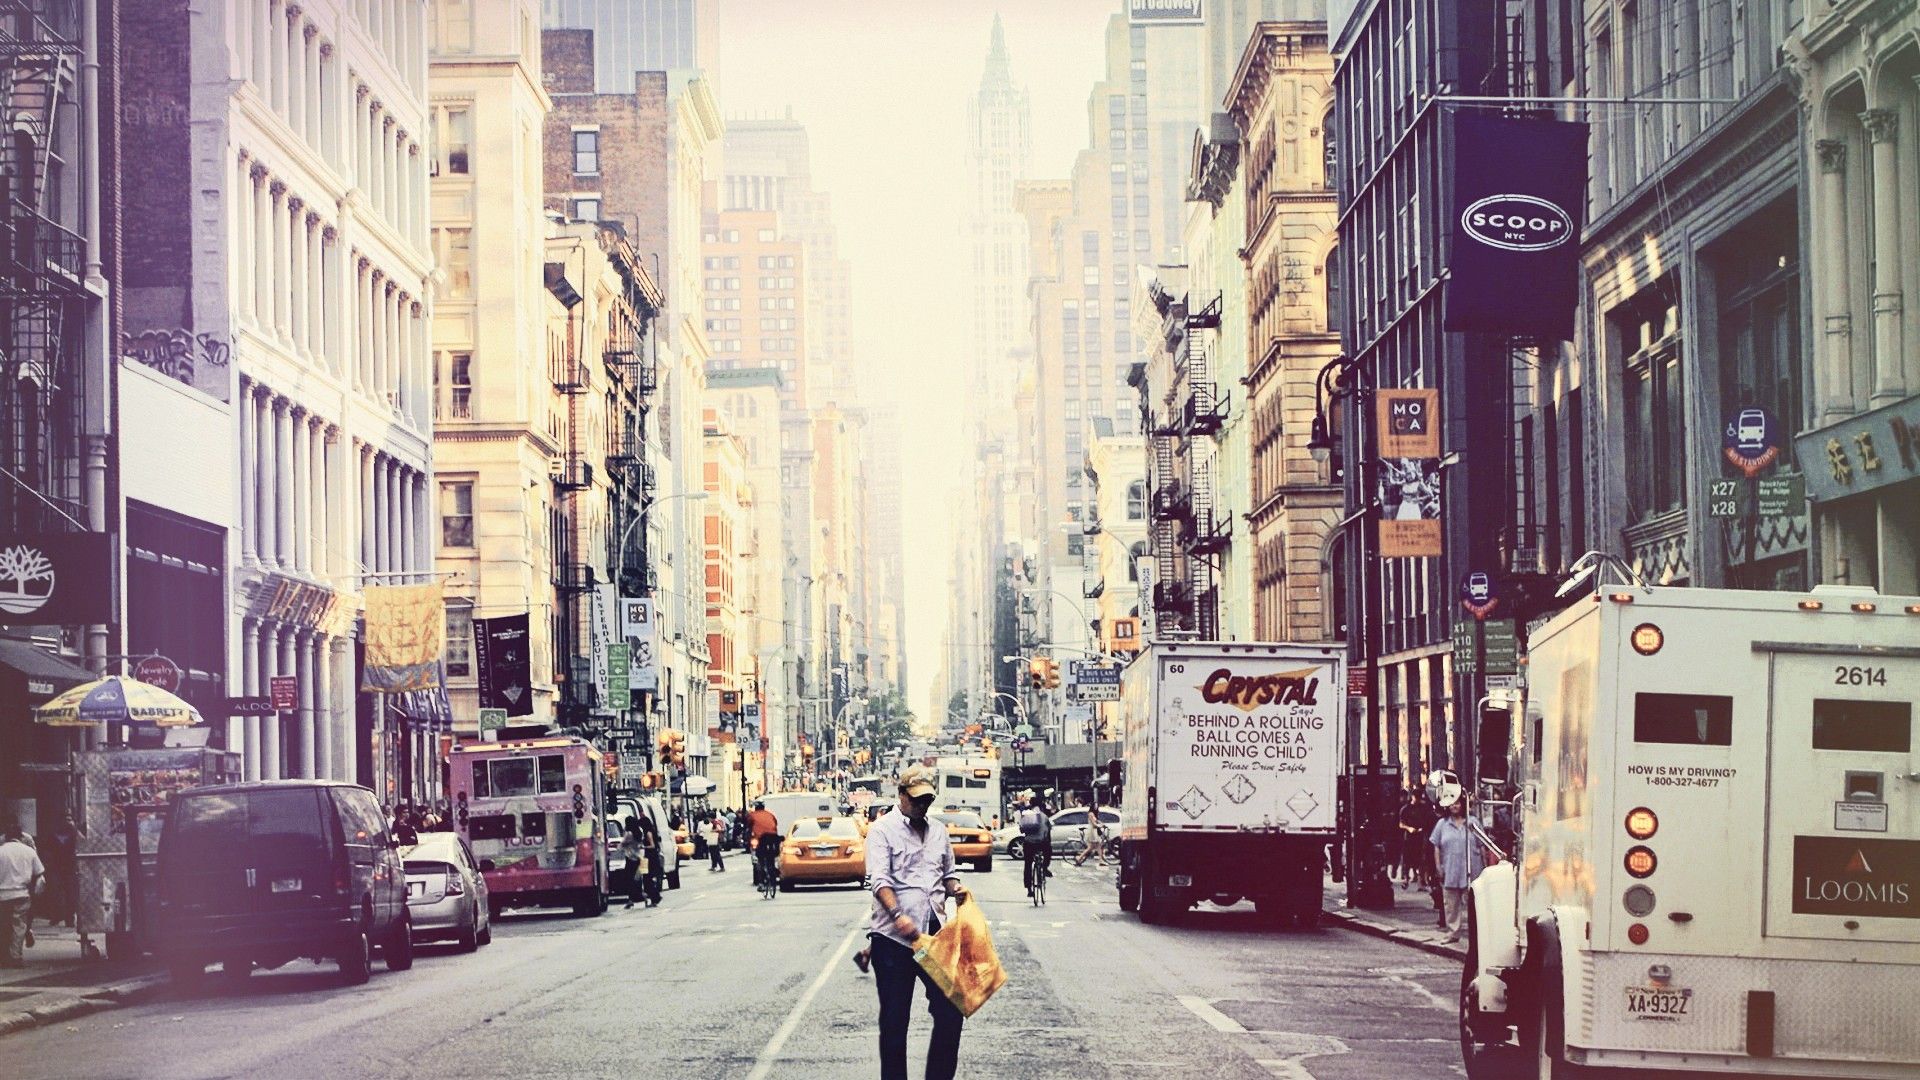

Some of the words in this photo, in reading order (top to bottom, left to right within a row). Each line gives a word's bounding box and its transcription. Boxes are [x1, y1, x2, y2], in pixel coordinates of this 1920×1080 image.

[1473, 213, 1562, 232] SCOOP
[1504, 232, 1526, 240] NYC
[140, 665, 173, 675] Jewelry
[1169, 664, 1184, 674] 60
[1835, 666, 1887, 687] 2614
[1202, 668, 1318, 706] CRYSTAL
[131, 707, 184, 717] SABRETT
[234, 702, 272, 711] ALDO
[1289, 706, 1315, 717] Says
[1183, 714, 1240, 728] "BEHIND
[1244, 716, 1255, 728] A
[1260, 716, 1324, 730] ROLLING
[1196, 730, 1231, 743] BALL
[1236, 731, 1290, 744] COMES
[1294, 732, 1305, 744] A
[1191, 745, 1259, 758] RUNNING
[1264, 745, 1313, 759] CHILD"
[1222, 761, 1249, 771] Please
[1252, 761, 1275, 771] Drive
[1278, 762, 1307, 774] Safely
[1628, 765, 1653, 775] HOW
[1656, 766, 1666, 775] IS
[1669, 767, 1685, 776] MY
[1687, 768, 1737, 777] DRIVING?
[1646, 777, 1719, 787] 1-800-327-4677
[1804, 876, 1909, 904] LOOMIS
